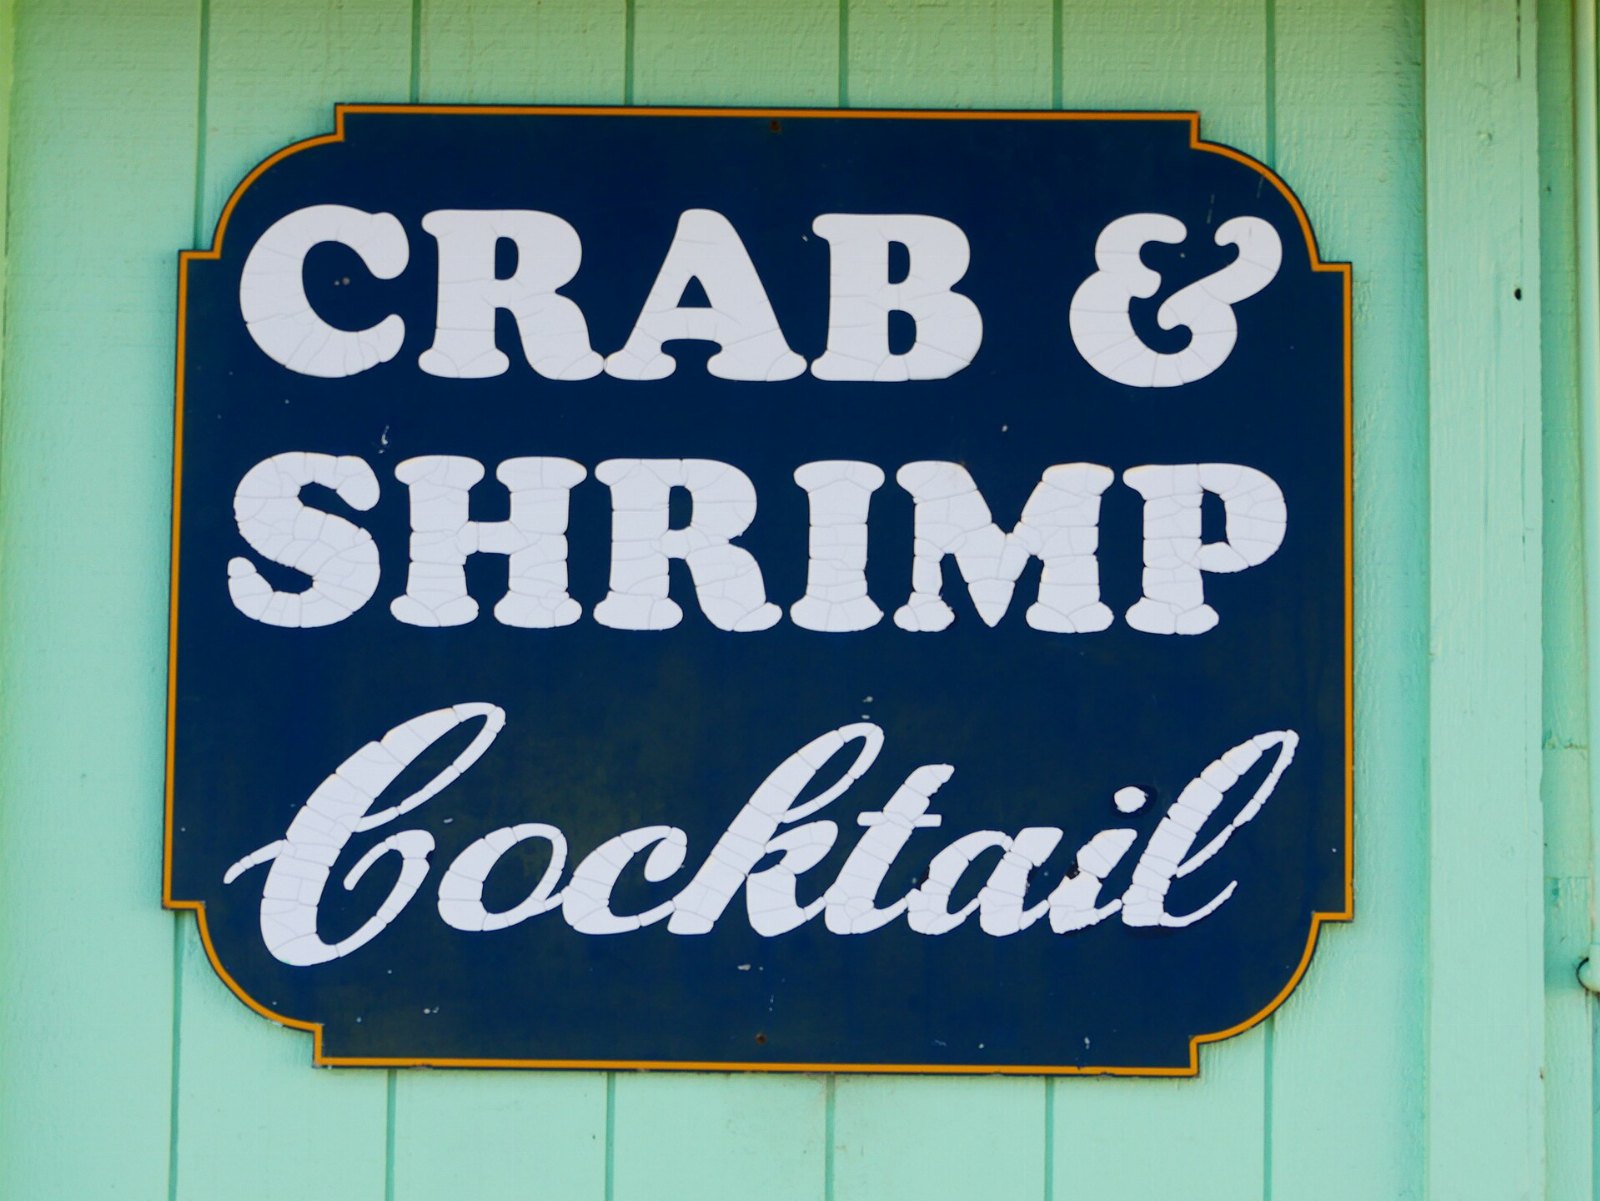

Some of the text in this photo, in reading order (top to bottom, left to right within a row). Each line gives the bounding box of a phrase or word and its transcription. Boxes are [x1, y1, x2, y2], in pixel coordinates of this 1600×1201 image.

[239, 204, 1282, 388] CRAB &
[227, 451, 1287, 635] SHRIMP
[223, 702, 1299, 966] Cocktail
